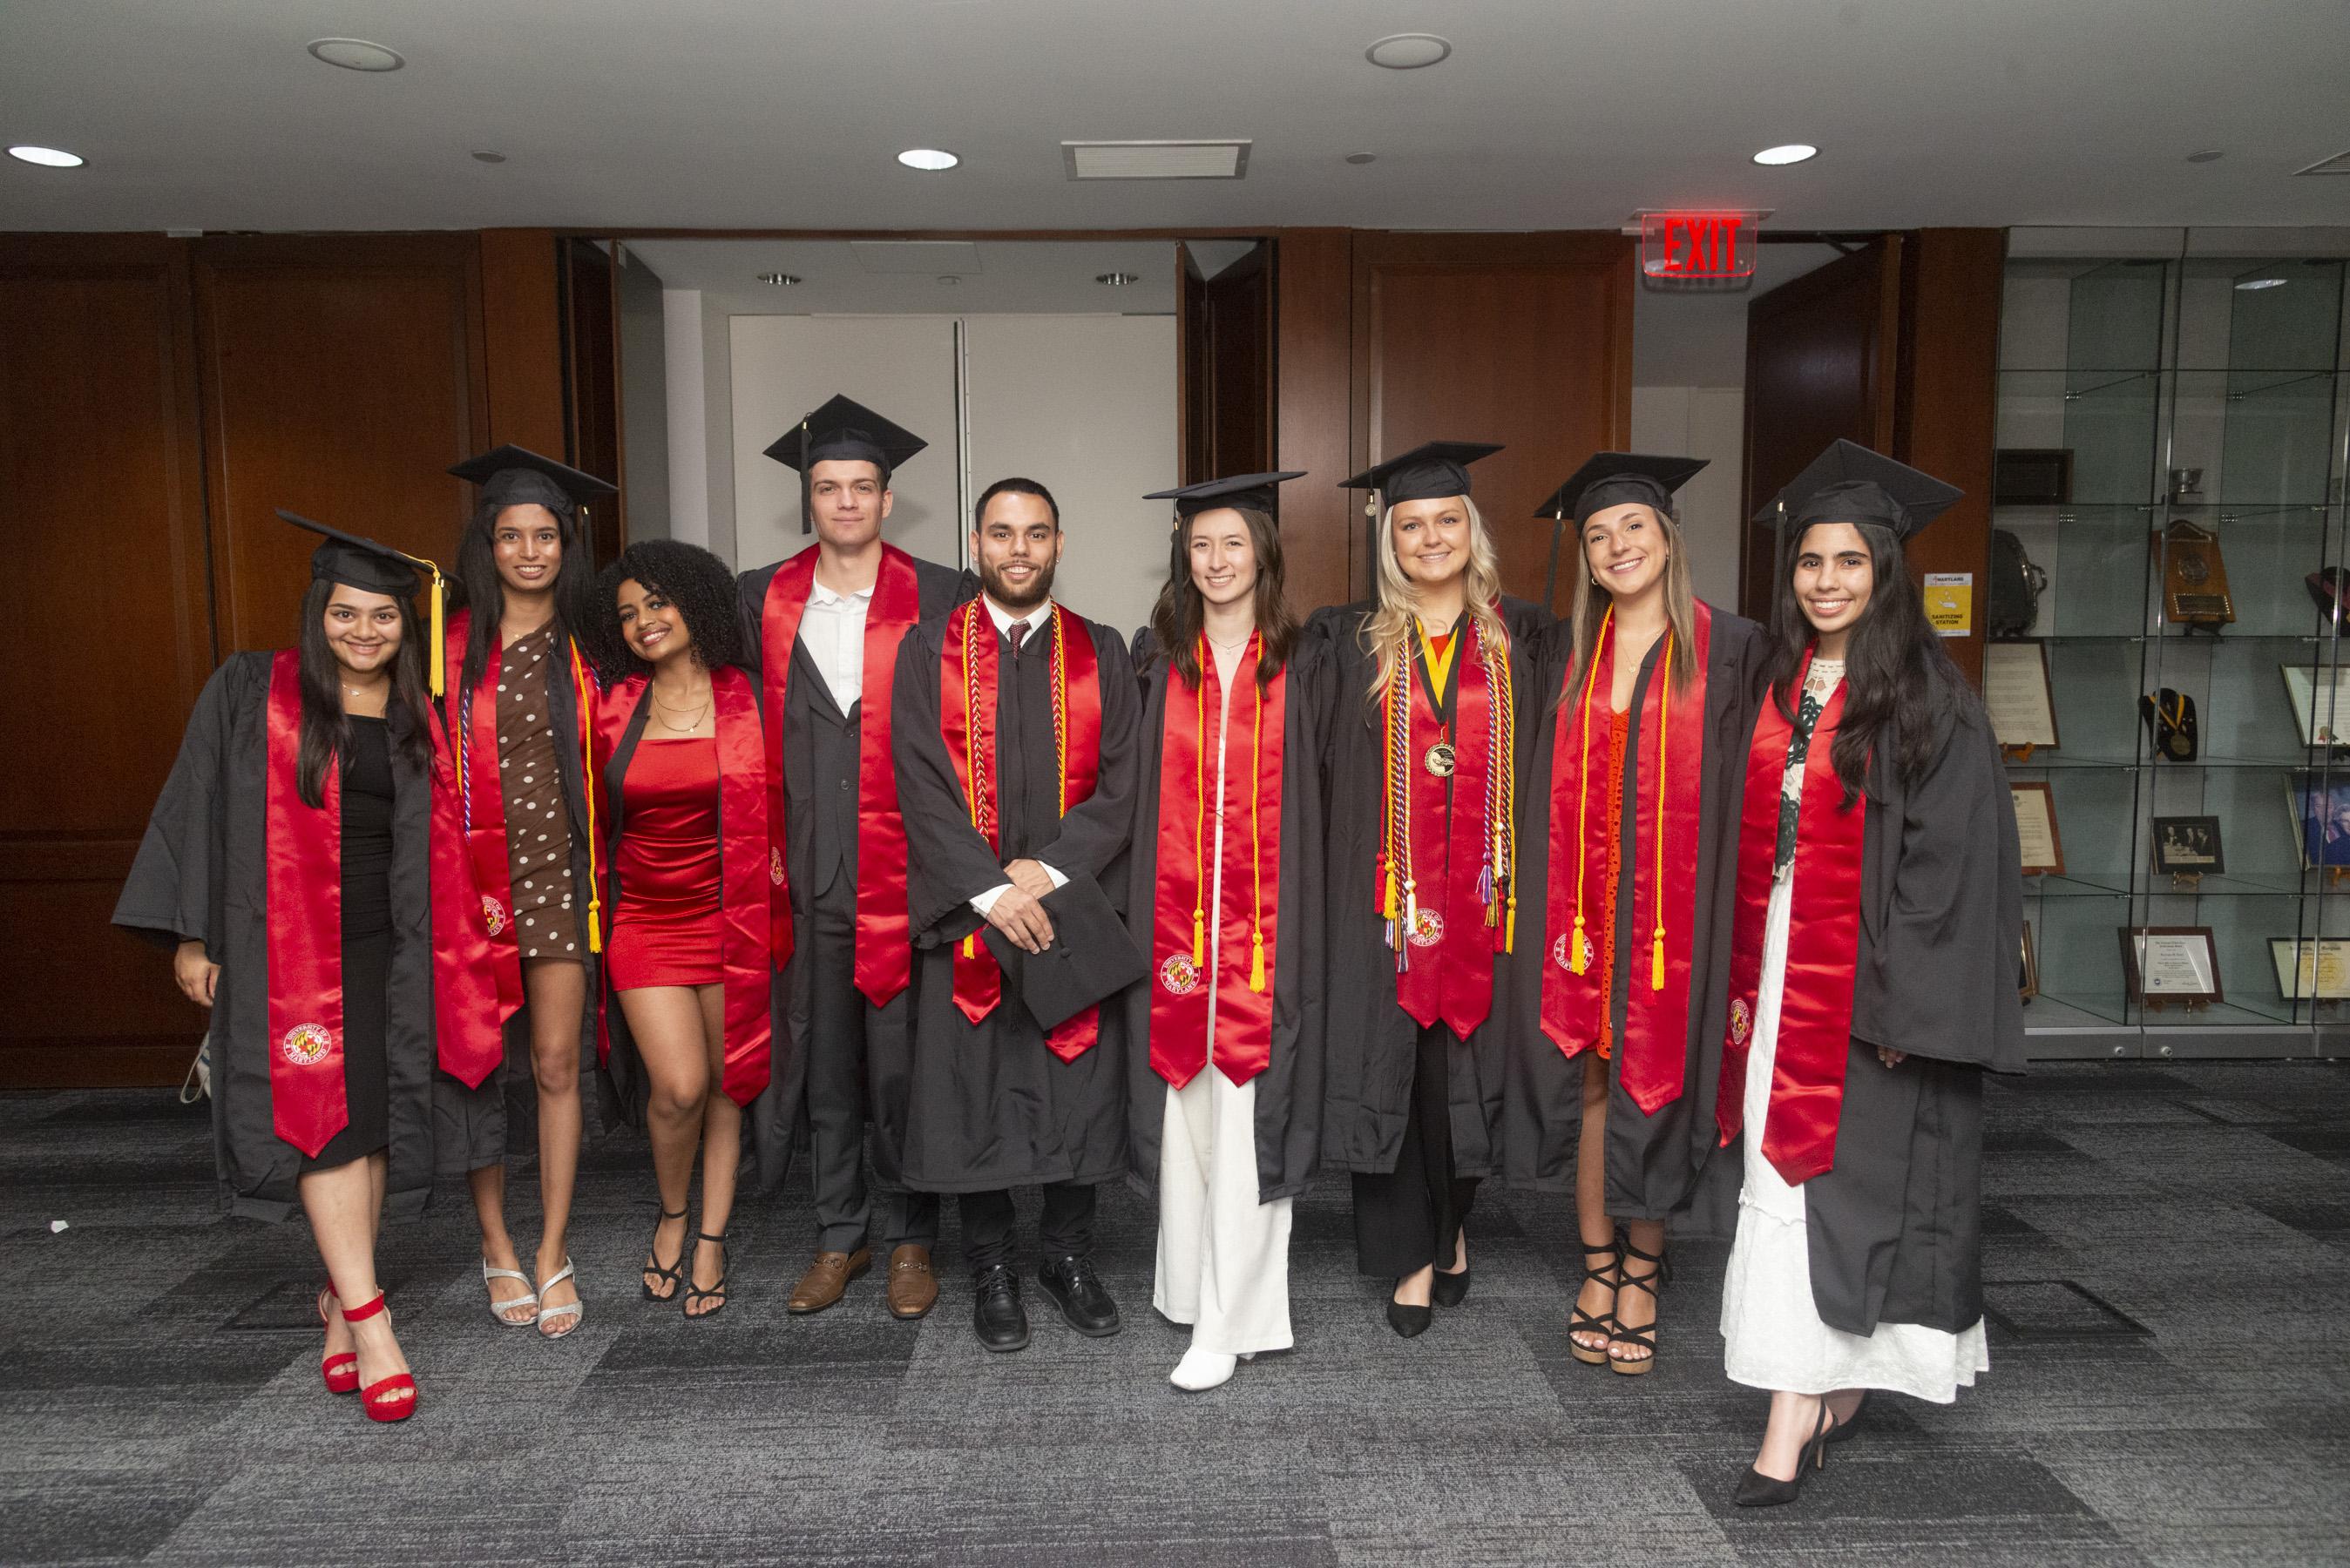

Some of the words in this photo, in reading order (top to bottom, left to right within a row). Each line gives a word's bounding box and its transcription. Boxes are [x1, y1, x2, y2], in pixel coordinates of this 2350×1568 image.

[1664, 219, 1742, 272] EXIT
[1164, 956, 1193, 969] UNIVERSITY
[1165, 981, 1196, 993] MARYLAND
[288, 1024, 322, 1041] UNIVERSITY
[289, 1049, 328, 1064] MARYLAND
